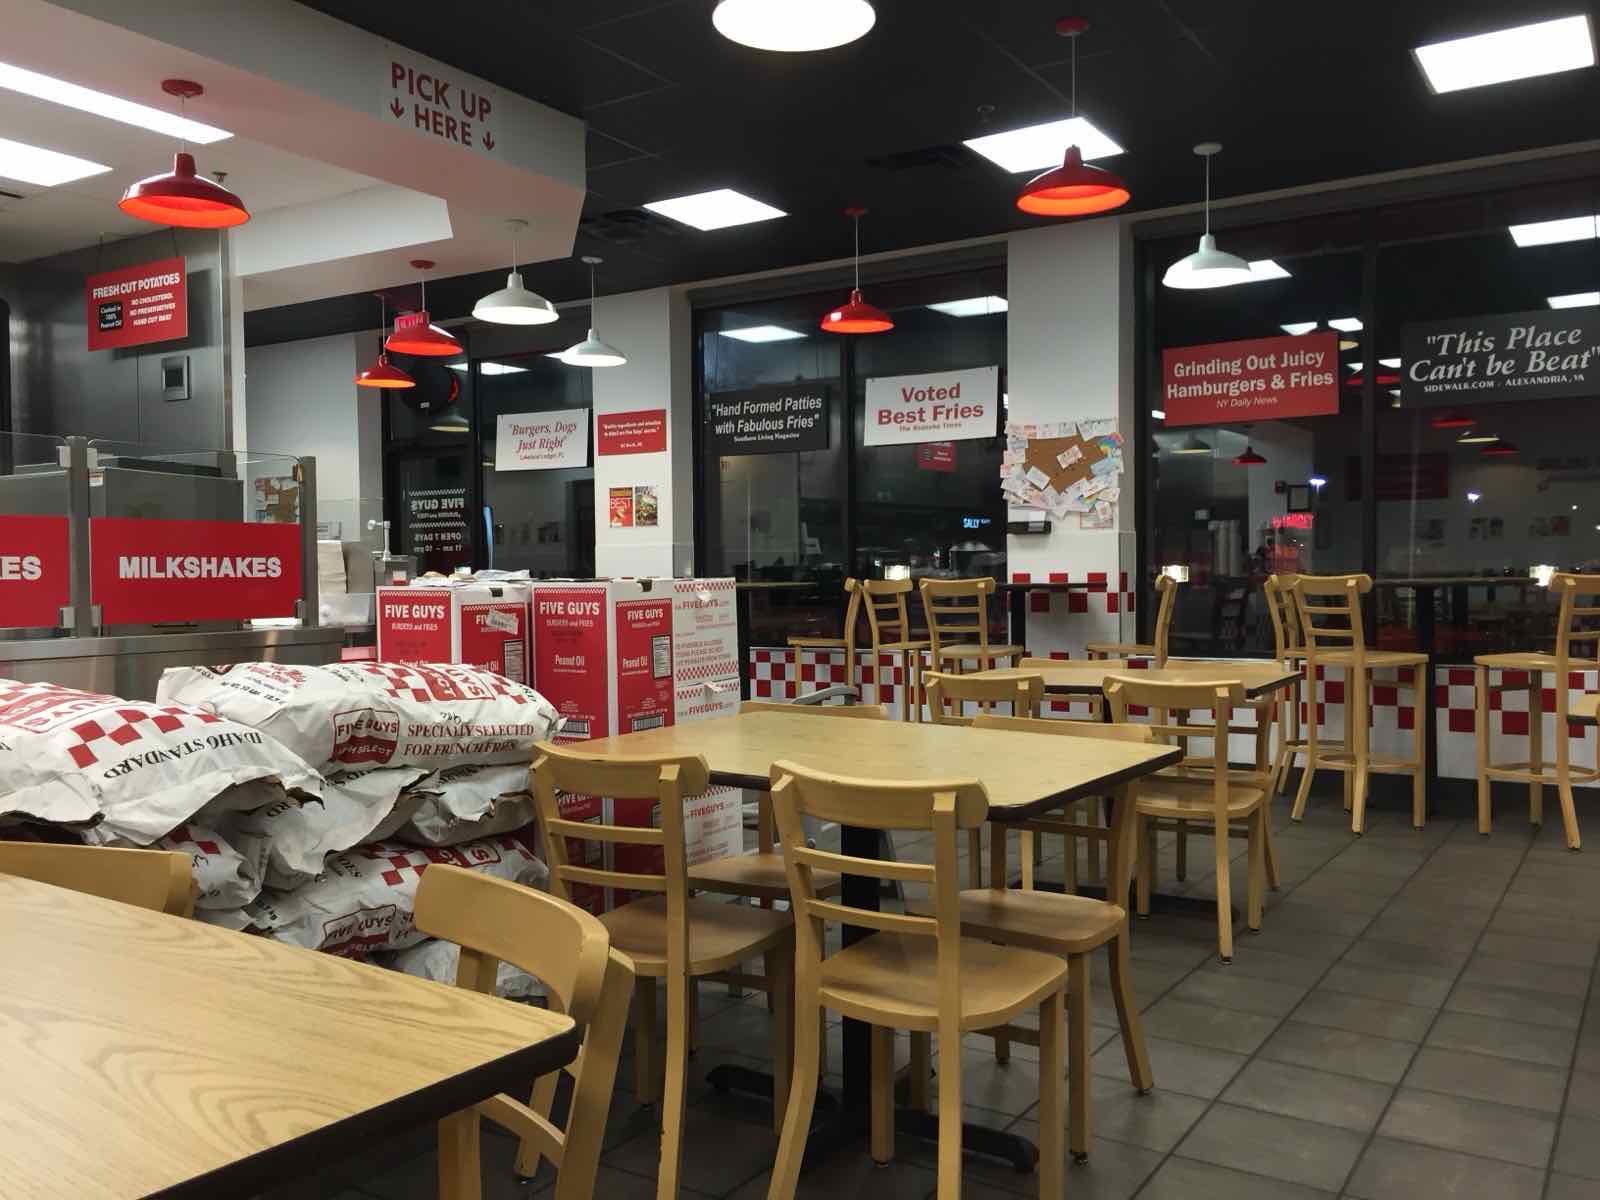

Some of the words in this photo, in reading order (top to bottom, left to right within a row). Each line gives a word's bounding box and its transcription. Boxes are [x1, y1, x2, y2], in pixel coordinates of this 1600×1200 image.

[392, 62, 450, 110] PICK
[461, 88, 492, 122] UP
[415, 103, 472, 146] HERE
[93, 284, 120, 299] FRESH
[121, 281, 137, 294] CUT
[138, 272, 180, 290] POTATOES
[1427, 331, 1496, 356] "This
[1506, 325, 1582, 350] Place
[1174, 357, 1242, 378] Grinding
[1246, 353, 1276, 371] Out
[1280, 349, 1325, 368] Juicy
[1409, 356, 1477, 382] Can't
[1486, 353, 1516, 377] be
[1525, 346, 1600, 374] Beat"
[901, 382, 960, 402] Voted
[1167, 378, 1266, 399] Hamburgers
[1271, 373, 1285, 389] &
[1290, 370, 1334, 388] Fries
[712, 402, 741, 416] "Hand
[743, 399, 782, 414] Formed
[785, 396, 822, 411] Patties
[1216, 399, 1229, 408] NY
[1230, 397, 1251, 408] Daily
[1253, 396, 1278, 405] News
[715, 421, 735, 434] with
[737, 418, 784, 433] Fabulous
[786, 413, 820, 429] Fries"
[877, 407, 926, 425] Best
[932, 403, 984, 421] Fries
[554, 421, 577, 434] Dogs
[515, 439, 536, 453] Just
[0, 556, 42, 580] ES
[119, 556, 282, 578] MILKSHAKES
[384, 604, 409, 618] FIVE
[412, 604, 445, 619] GUYS
[539, 601, 565, 615] FIVE
[567, 601, 600, 616] GUYS
[627, 609, 644, 621] FIVE
[645, 608, 664, 620] GUYS
[555, 654, 574, 666] Peanut
[575, 655, 585, 666] Oil
[622, 658, 640, 669] Peanut
[640, 655, 648, 667] Oil
[407, 723, 475, 737] SPECIALLY
[475, 723, 535, 737] SELECTED
[205, 731, 264, 750] IDAHO
[403, 743, 432, 756] FOR
[434, 741, 482, 755] FRENCH
[103, 735, 206, 780] STANDARD
